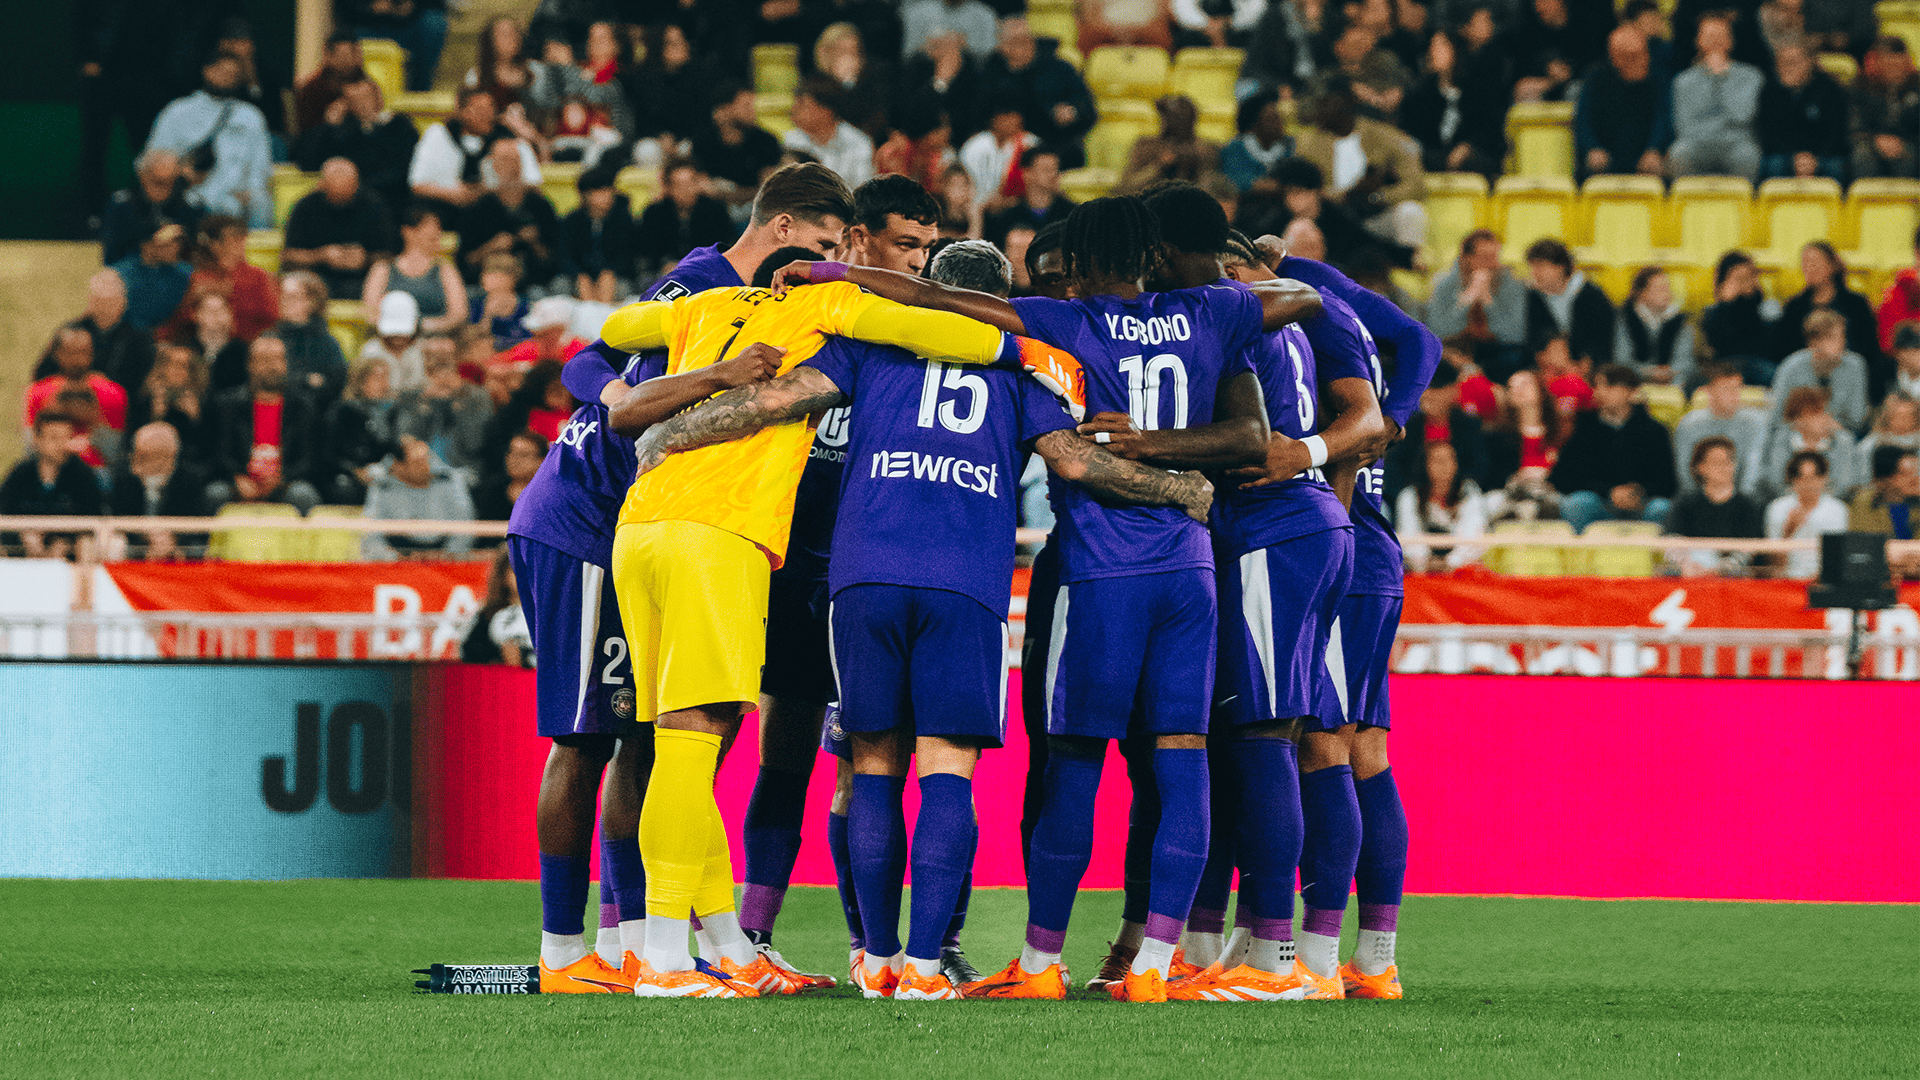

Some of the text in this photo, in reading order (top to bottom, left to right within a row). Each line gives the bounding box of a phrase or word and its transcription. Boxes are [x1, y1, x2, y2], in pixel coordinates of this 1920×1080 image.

[1104, 312, 1191, 345] Y.GBOHO
[917, 360, 989, 434] 15
[1118, 353, 1189, 431] 10
[601, 636, 633, 685] 2
[451, 969, 529, 984] ABATILLES
